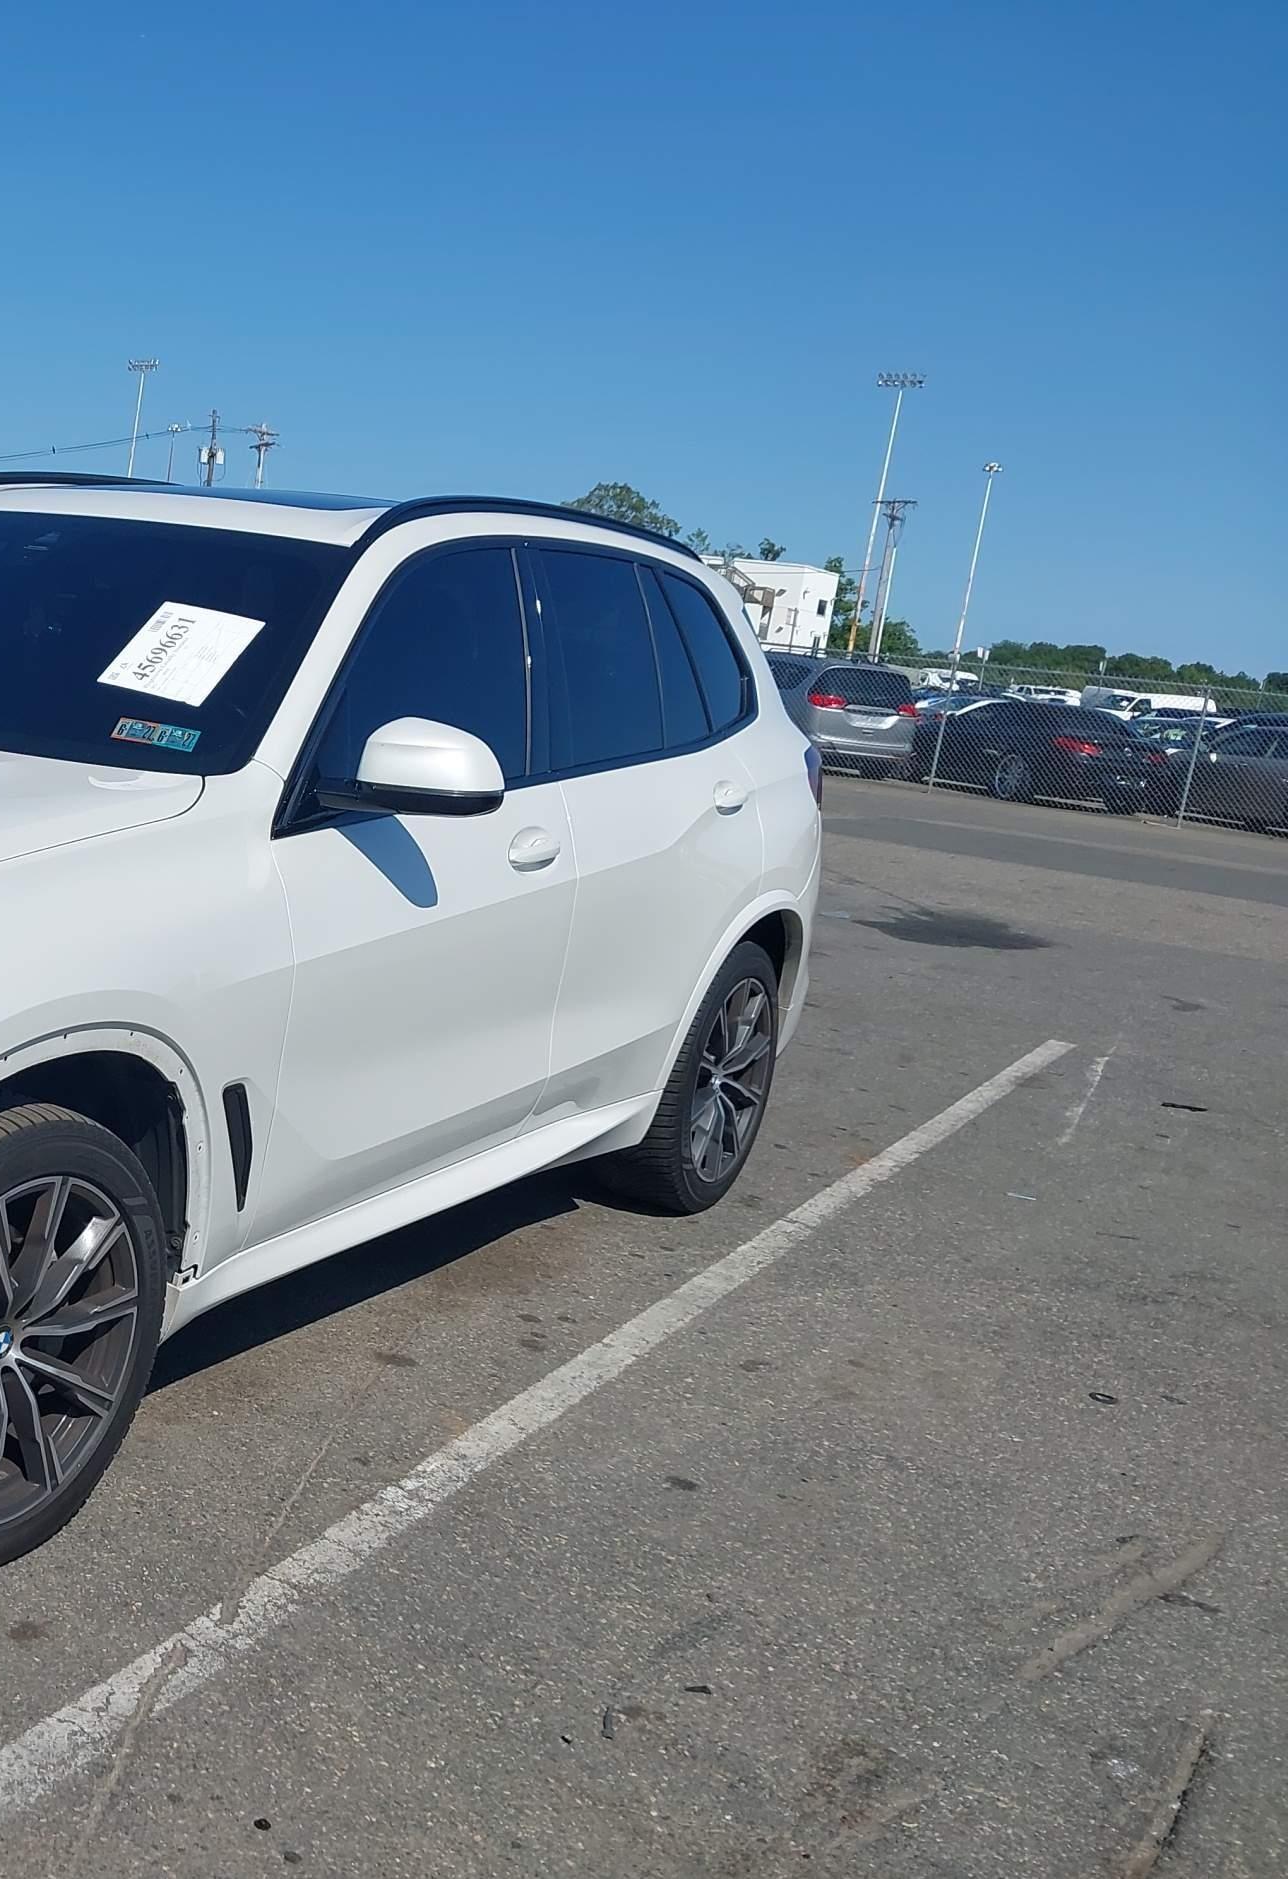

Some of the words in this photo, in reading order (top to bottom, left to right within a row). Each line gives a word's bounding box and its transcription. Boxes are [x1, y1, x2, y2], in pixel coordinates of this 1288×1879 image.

[131, 617, 197, 681] 45696631
[117, 723, 128, 736] 6
[157, 730, 168, 743] 6
